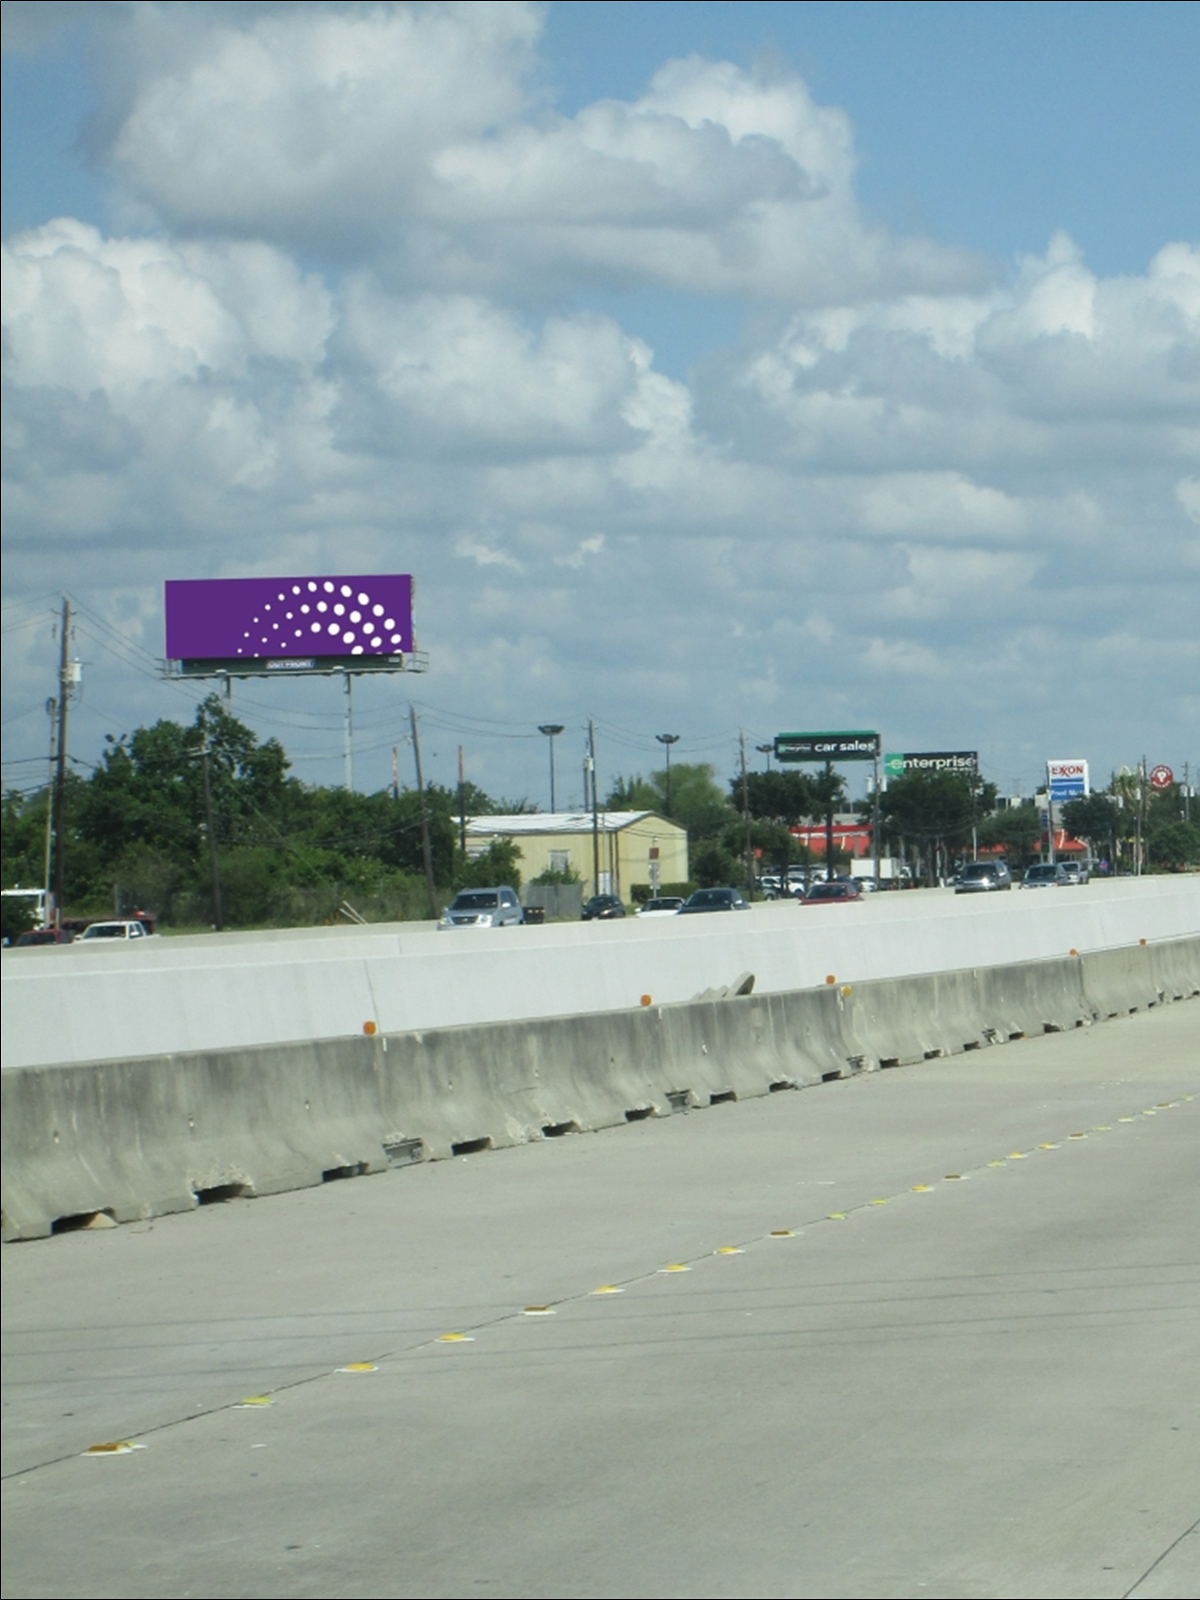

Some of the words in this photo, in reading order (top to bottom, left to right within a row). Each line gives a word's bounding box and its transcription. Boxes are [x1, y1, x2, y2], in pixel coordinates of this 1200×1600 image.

[814, 743, 836, 752] car
[839, 740, 876, 752] sales
[890, 756, 975, 771] enterprise
[1052, 766, 1083, 777] EXXON
